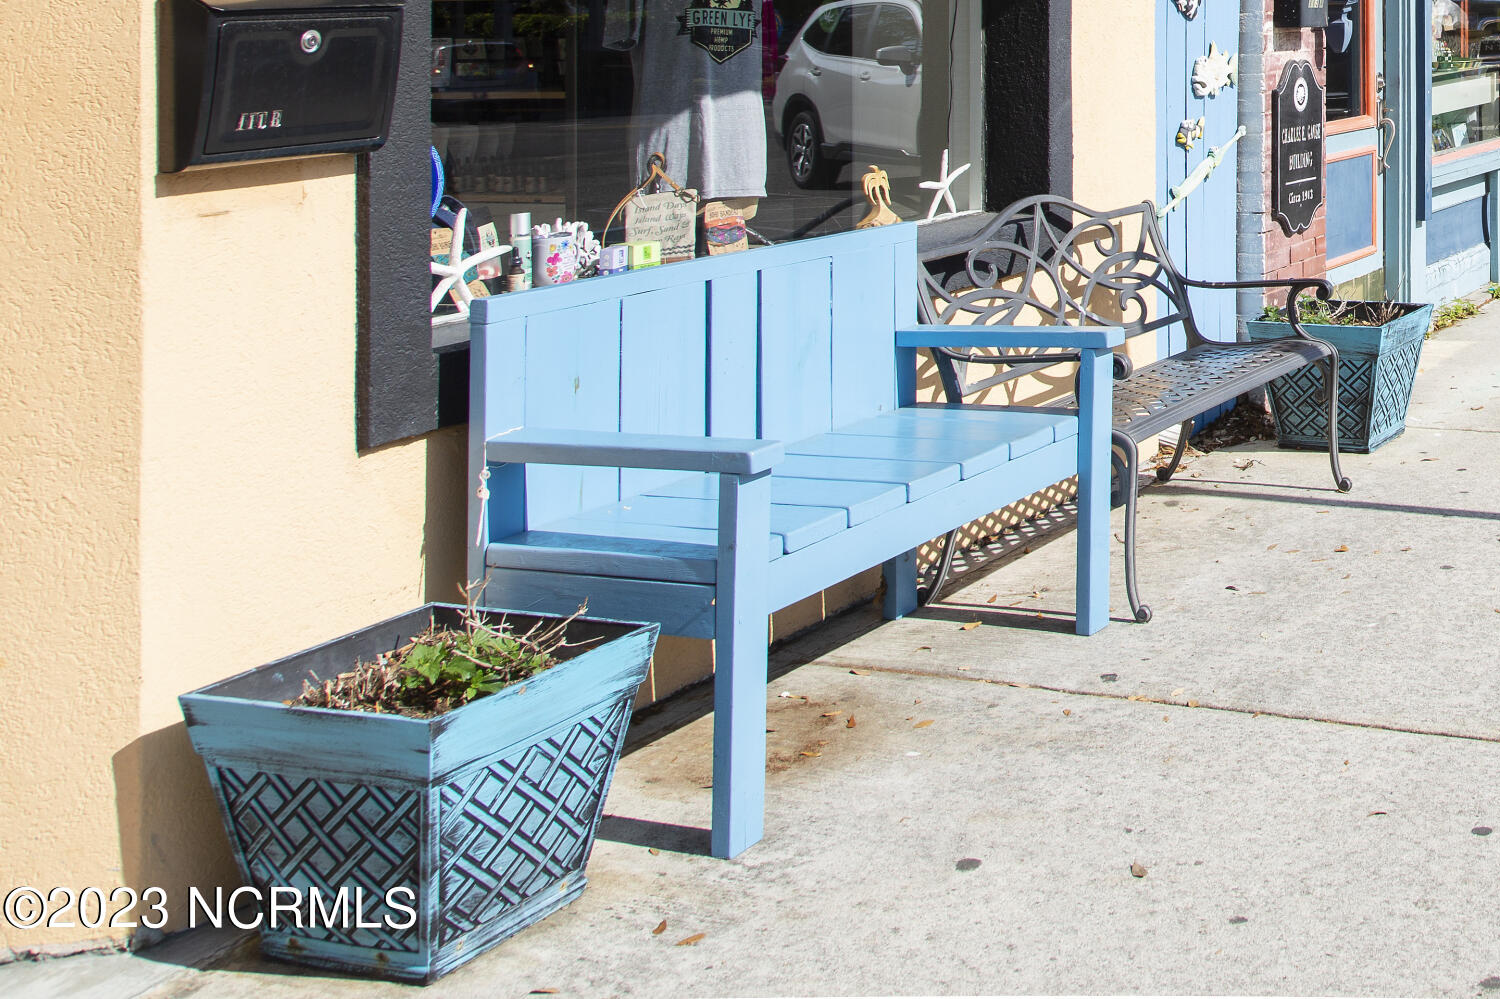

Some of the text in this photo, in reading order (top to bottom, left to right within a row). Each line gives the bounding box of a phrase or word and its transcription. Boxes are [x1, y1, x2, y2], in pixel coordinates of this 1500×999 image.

[693, 10, 752, 28] GREEN LYF
[1288, 151, 1313, 171] BUILDING
